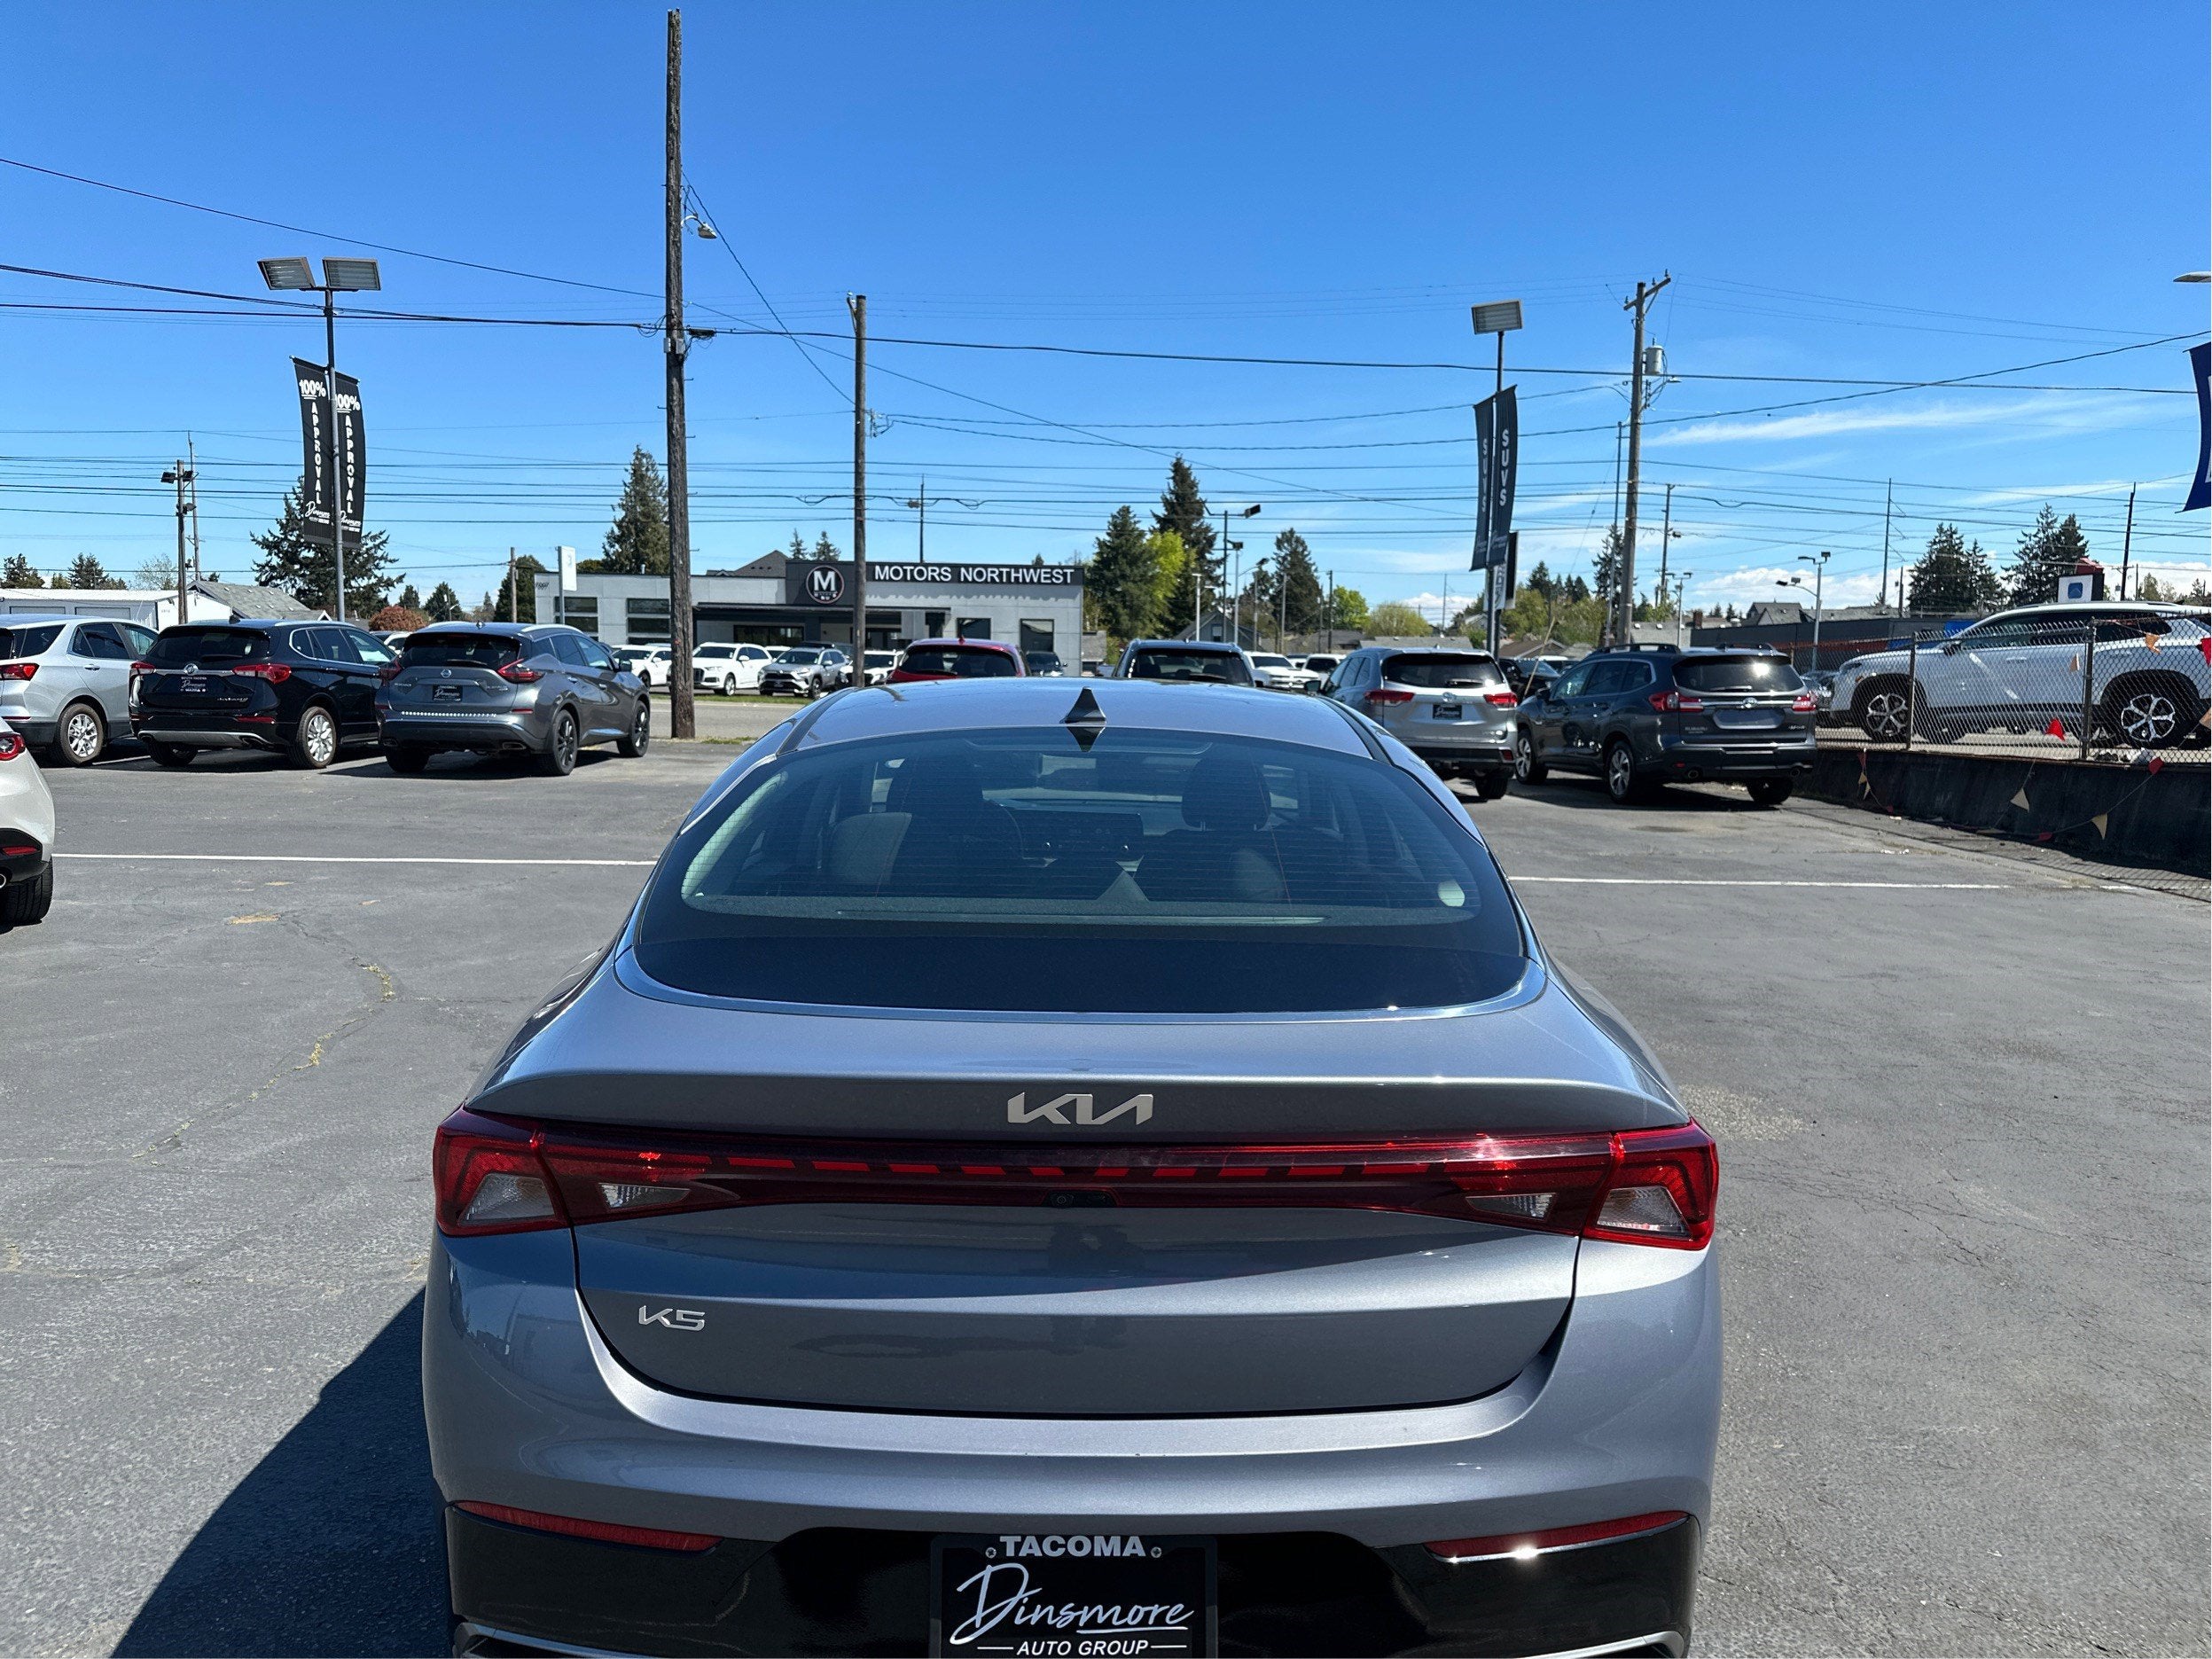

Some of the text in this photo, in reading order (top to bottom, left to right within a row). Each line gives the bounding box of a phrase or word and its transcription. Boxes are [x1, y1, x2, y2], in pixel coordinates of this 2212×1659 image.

[299, 379, 326, 397] 100%
[311, 402, 322, 505] APPROVAL
[345, 414, 356, 513] APPROVAL
[1499, 428, 1510, 506] SUVS
[813, 570, 836, 591] M
[874, 565, 1075, 584] MOTORS NORTHWEST
[1007, 1092, 1153, 1125] KIA
[638, 1305, 706, 1331] K5
[999, 1536, 1145, 1557] TACOMA
[950, 1562, 1194, 1645] Dinsmore
[1016, 1640, 1149, 1656] AUTO GROUP
